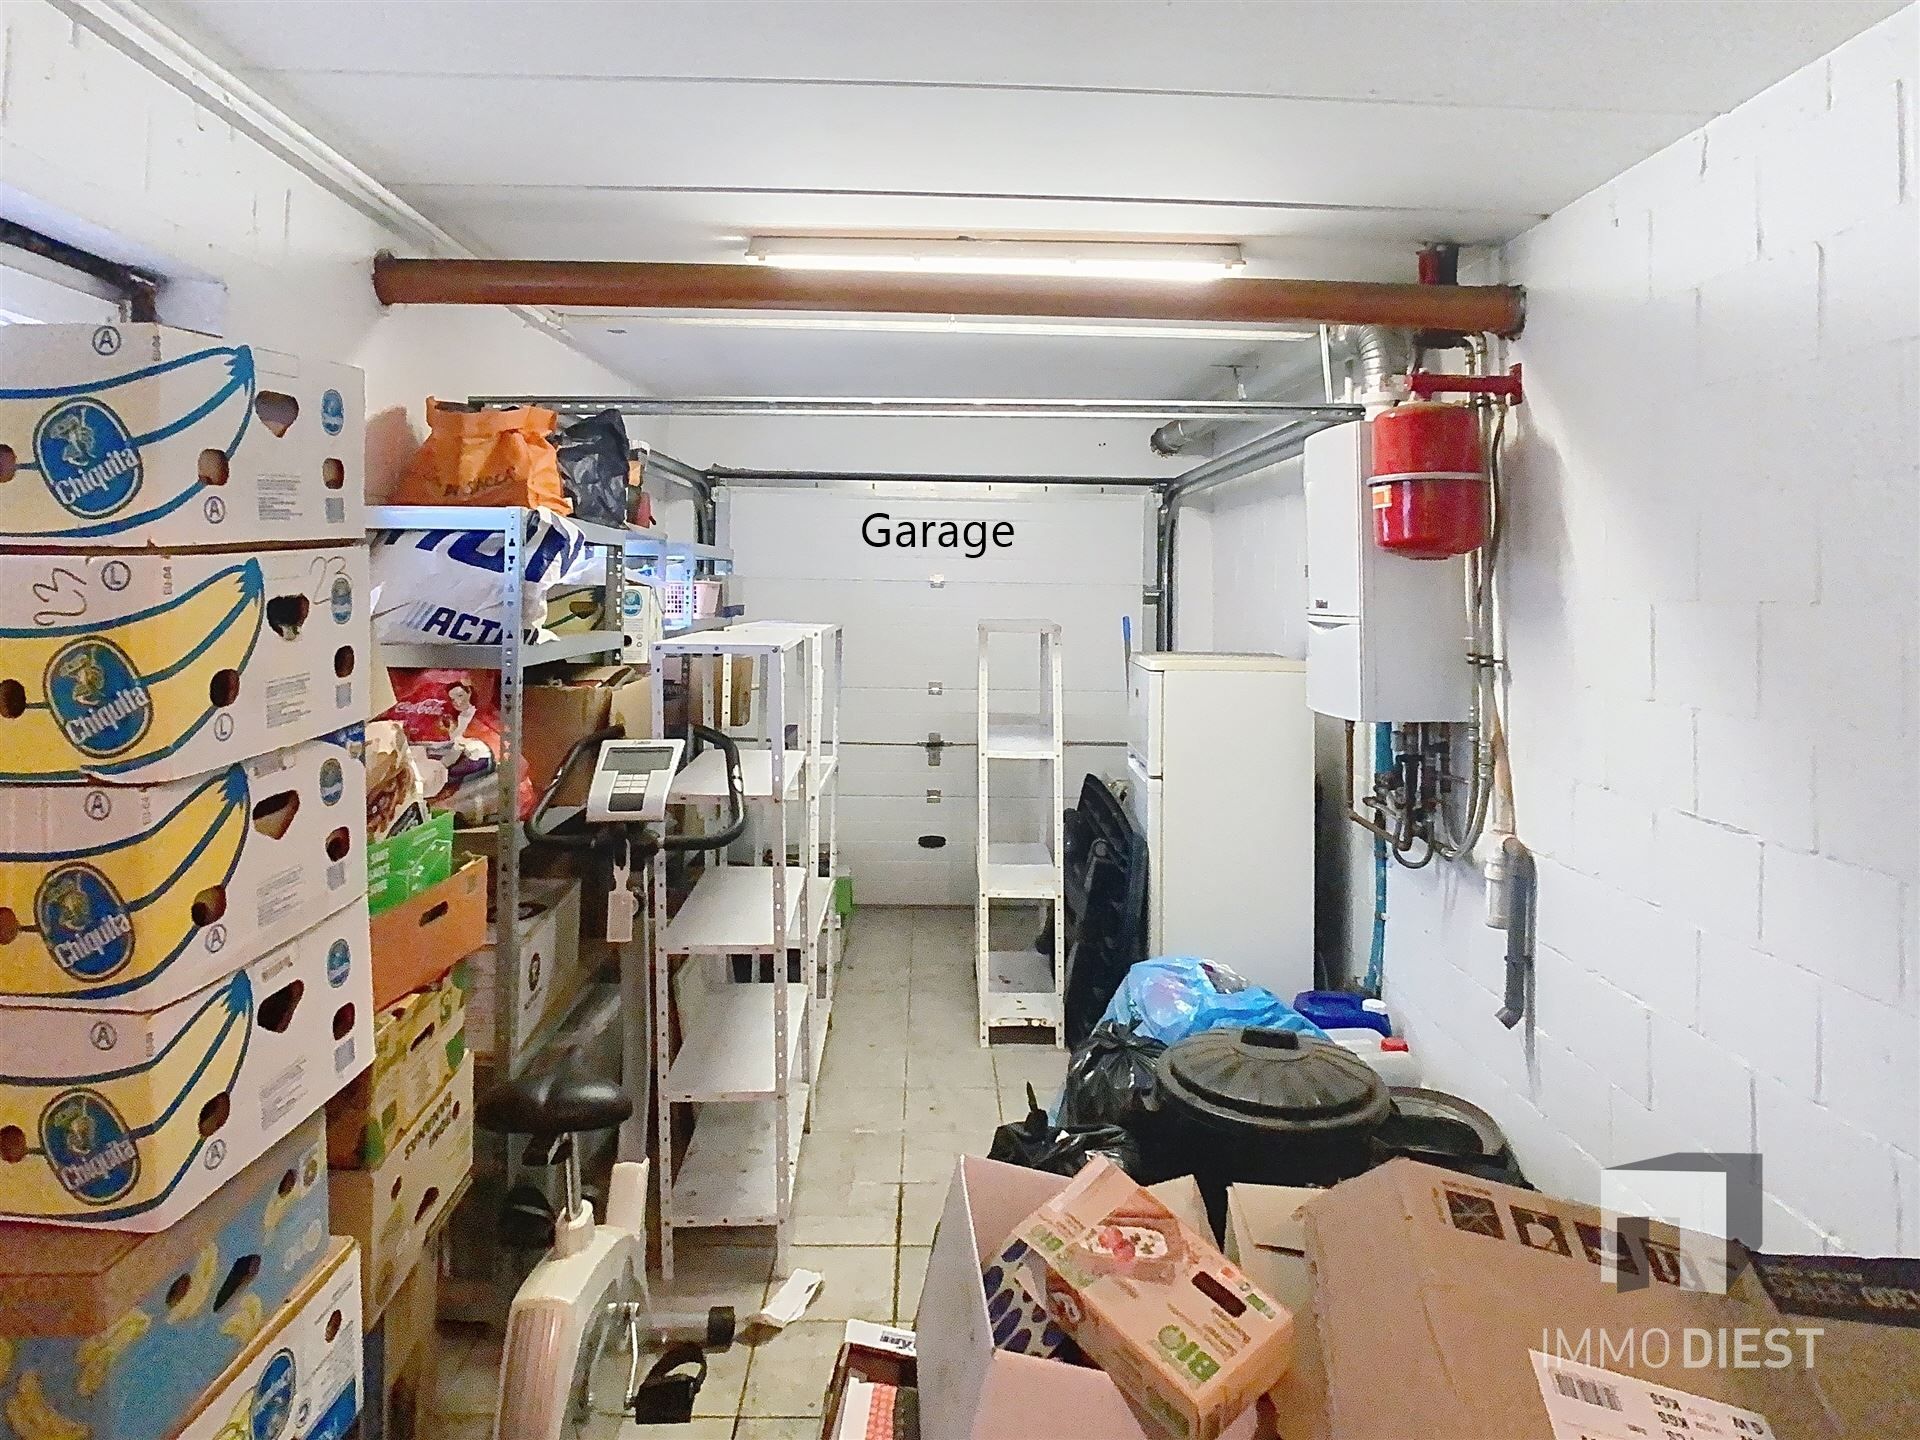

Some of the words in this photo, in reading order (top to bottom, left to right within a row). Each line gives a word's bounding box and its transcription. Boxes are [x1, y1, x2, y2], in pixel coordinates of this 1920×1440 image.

[55, 447, 139, 506] Chiquita
[65, 685, 149, 745] Chiquita
[54, 913, 132, 968] Chiquita
[60, 1139, 136, 1191] Chiquita
